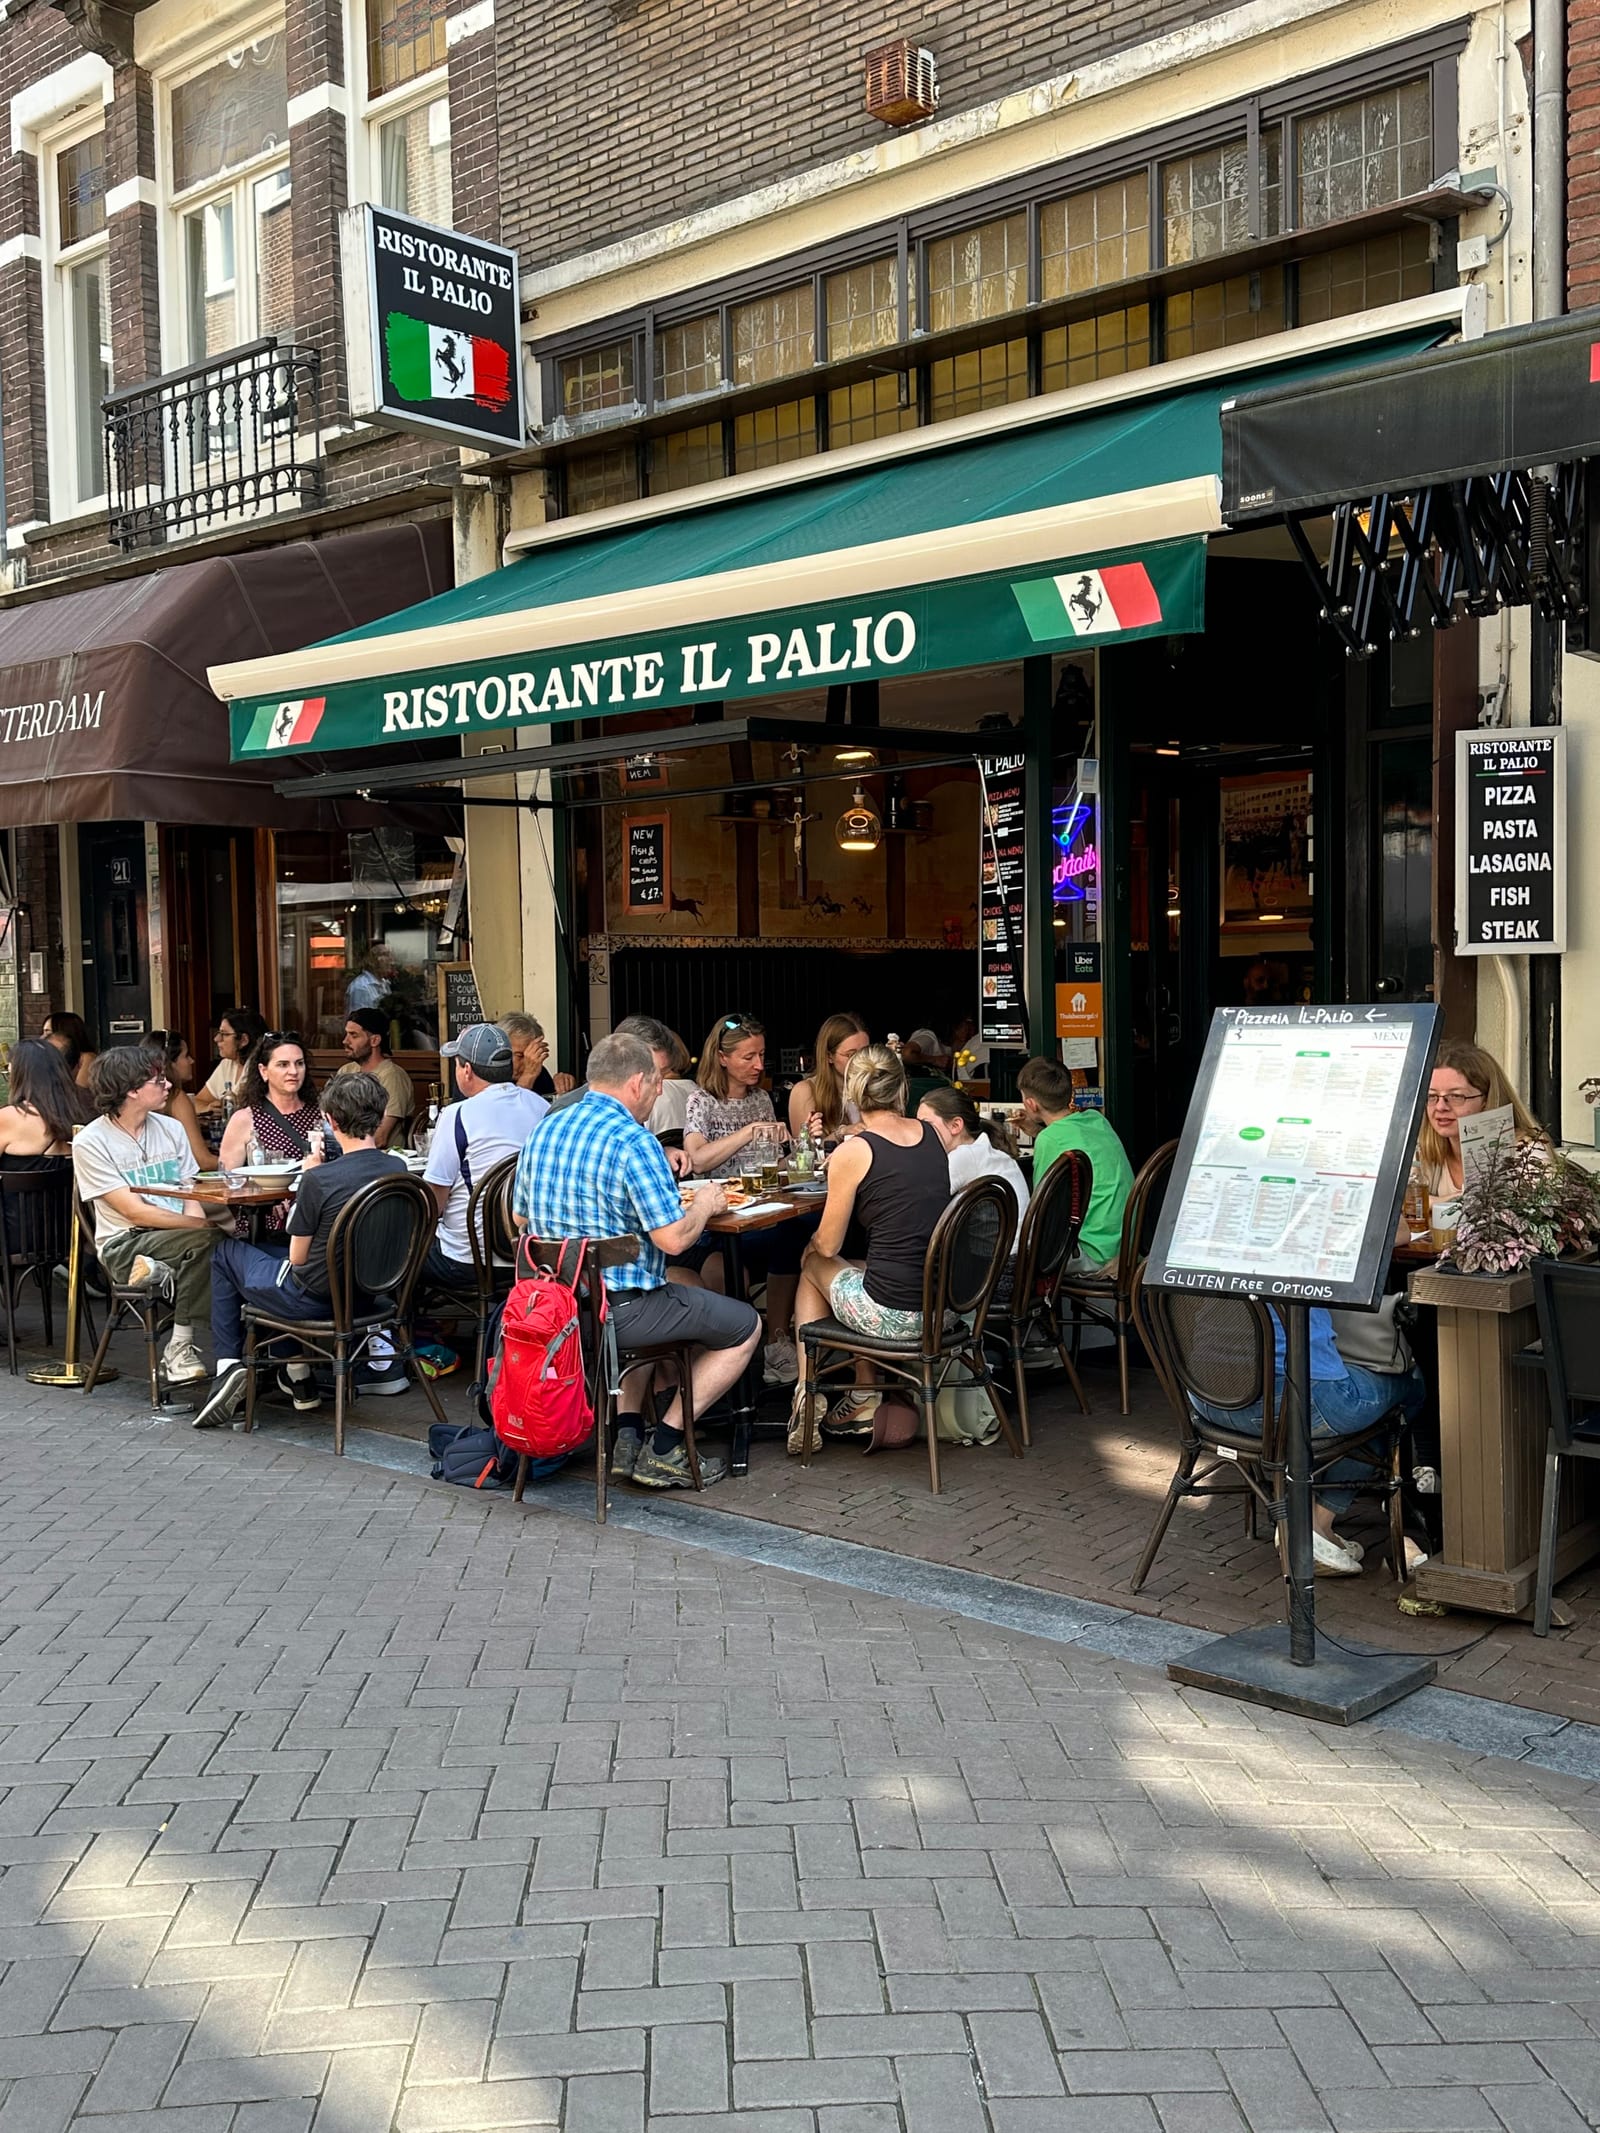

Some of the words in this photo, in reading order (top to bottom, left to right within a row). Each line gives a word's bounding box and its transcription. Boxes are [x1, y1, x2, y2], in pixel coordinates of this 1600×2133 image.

[377, 225, 512, 290] RISTORANTE
[402, 267, 426, 294] IL
[430, 276, 493, 315] PALIO
[1240, 492, 1266, 503] soons
[382, 651, 665, 733] RISTORANTE
[680, 642, 732, 694] IL
[747, 611, 916, 684] PALIO
[1470, 739, 1552, 755] RISTORANTE
[1483, 759, 1496, 770] IL
[1499, 756, 1538, 769] PALIO
[1003, 787, 1020, 798] MENU
[1484, 785, 1536, 806] PIZZA
[633, 829, 654, 841] NEW
[1483, 819, 1538, 839] PASTA
[113, 861, 128, 881] 21
[1470, 852, 1552, 874] LASAGNA
[1490, 886, 1530, 906] FISH
[983, 905, 1003, 916] CHICKE
[1481, 920, 1540, 940] STEAK
[1074, 956, 1093, 964] Uber
[1074, 965, 1094, 973] Eats
[1372, 1031, 1408, 1042] MENU
[1162, 1269, 1225, 1289] GLUTEN
[1230, 1277, 1264, 1290] FREE
[1271, 1281, 1333, 1298] OPTIONS
